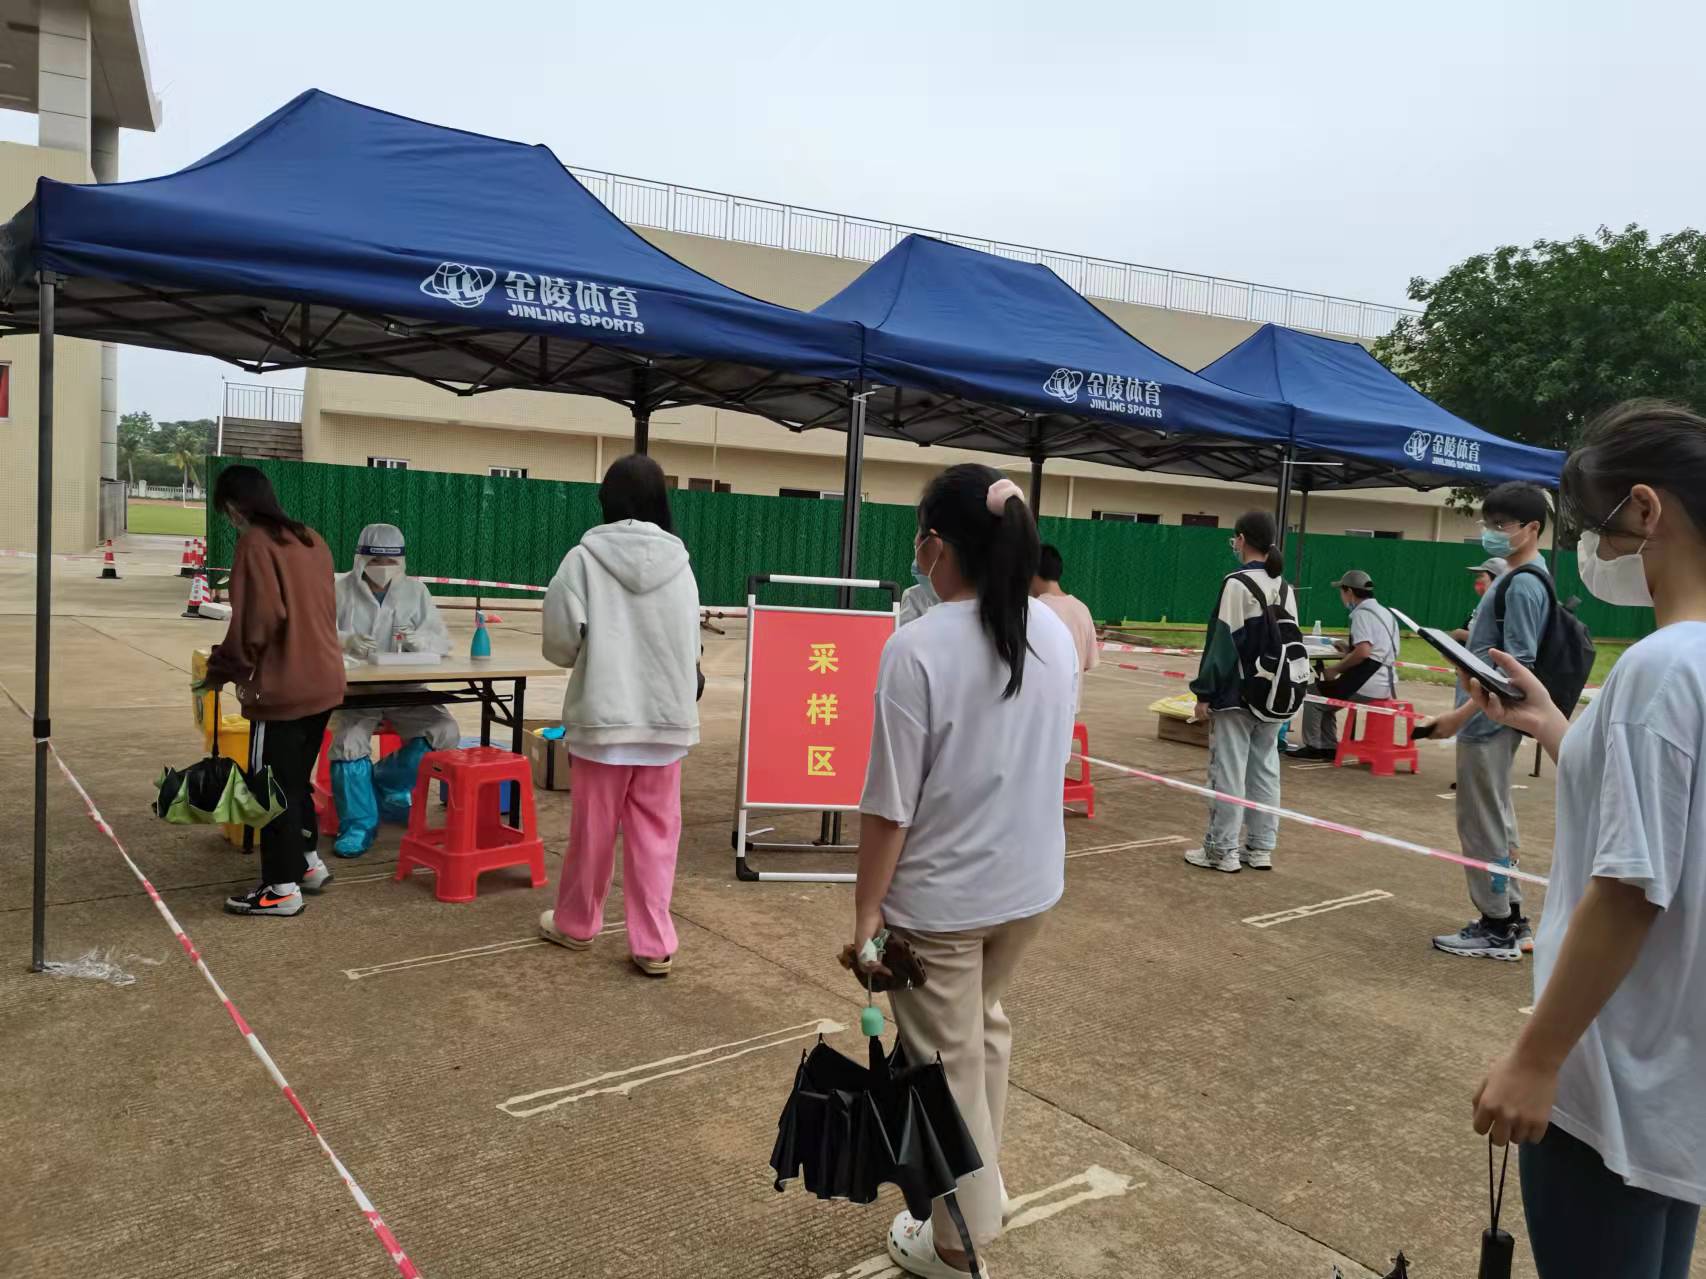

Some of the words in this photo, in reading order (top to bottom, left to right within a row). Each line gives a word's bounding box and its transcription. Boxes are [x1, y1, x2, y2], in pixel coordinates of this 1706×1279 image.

[505, 270, 639, 318] 金陵体育
[508, 304, 576, 324] JINLING
[580, 313, 644, 334] SPORTS
[1087, 372, 1161, 406] 金陵体育
[1090, 398, 1126, 413] JINLING
[1127, 403, 1162, 418] SPORTS
[1432, 434, 1480, 462] 金陵体育
[806, 643, 839, 776] 采样区
